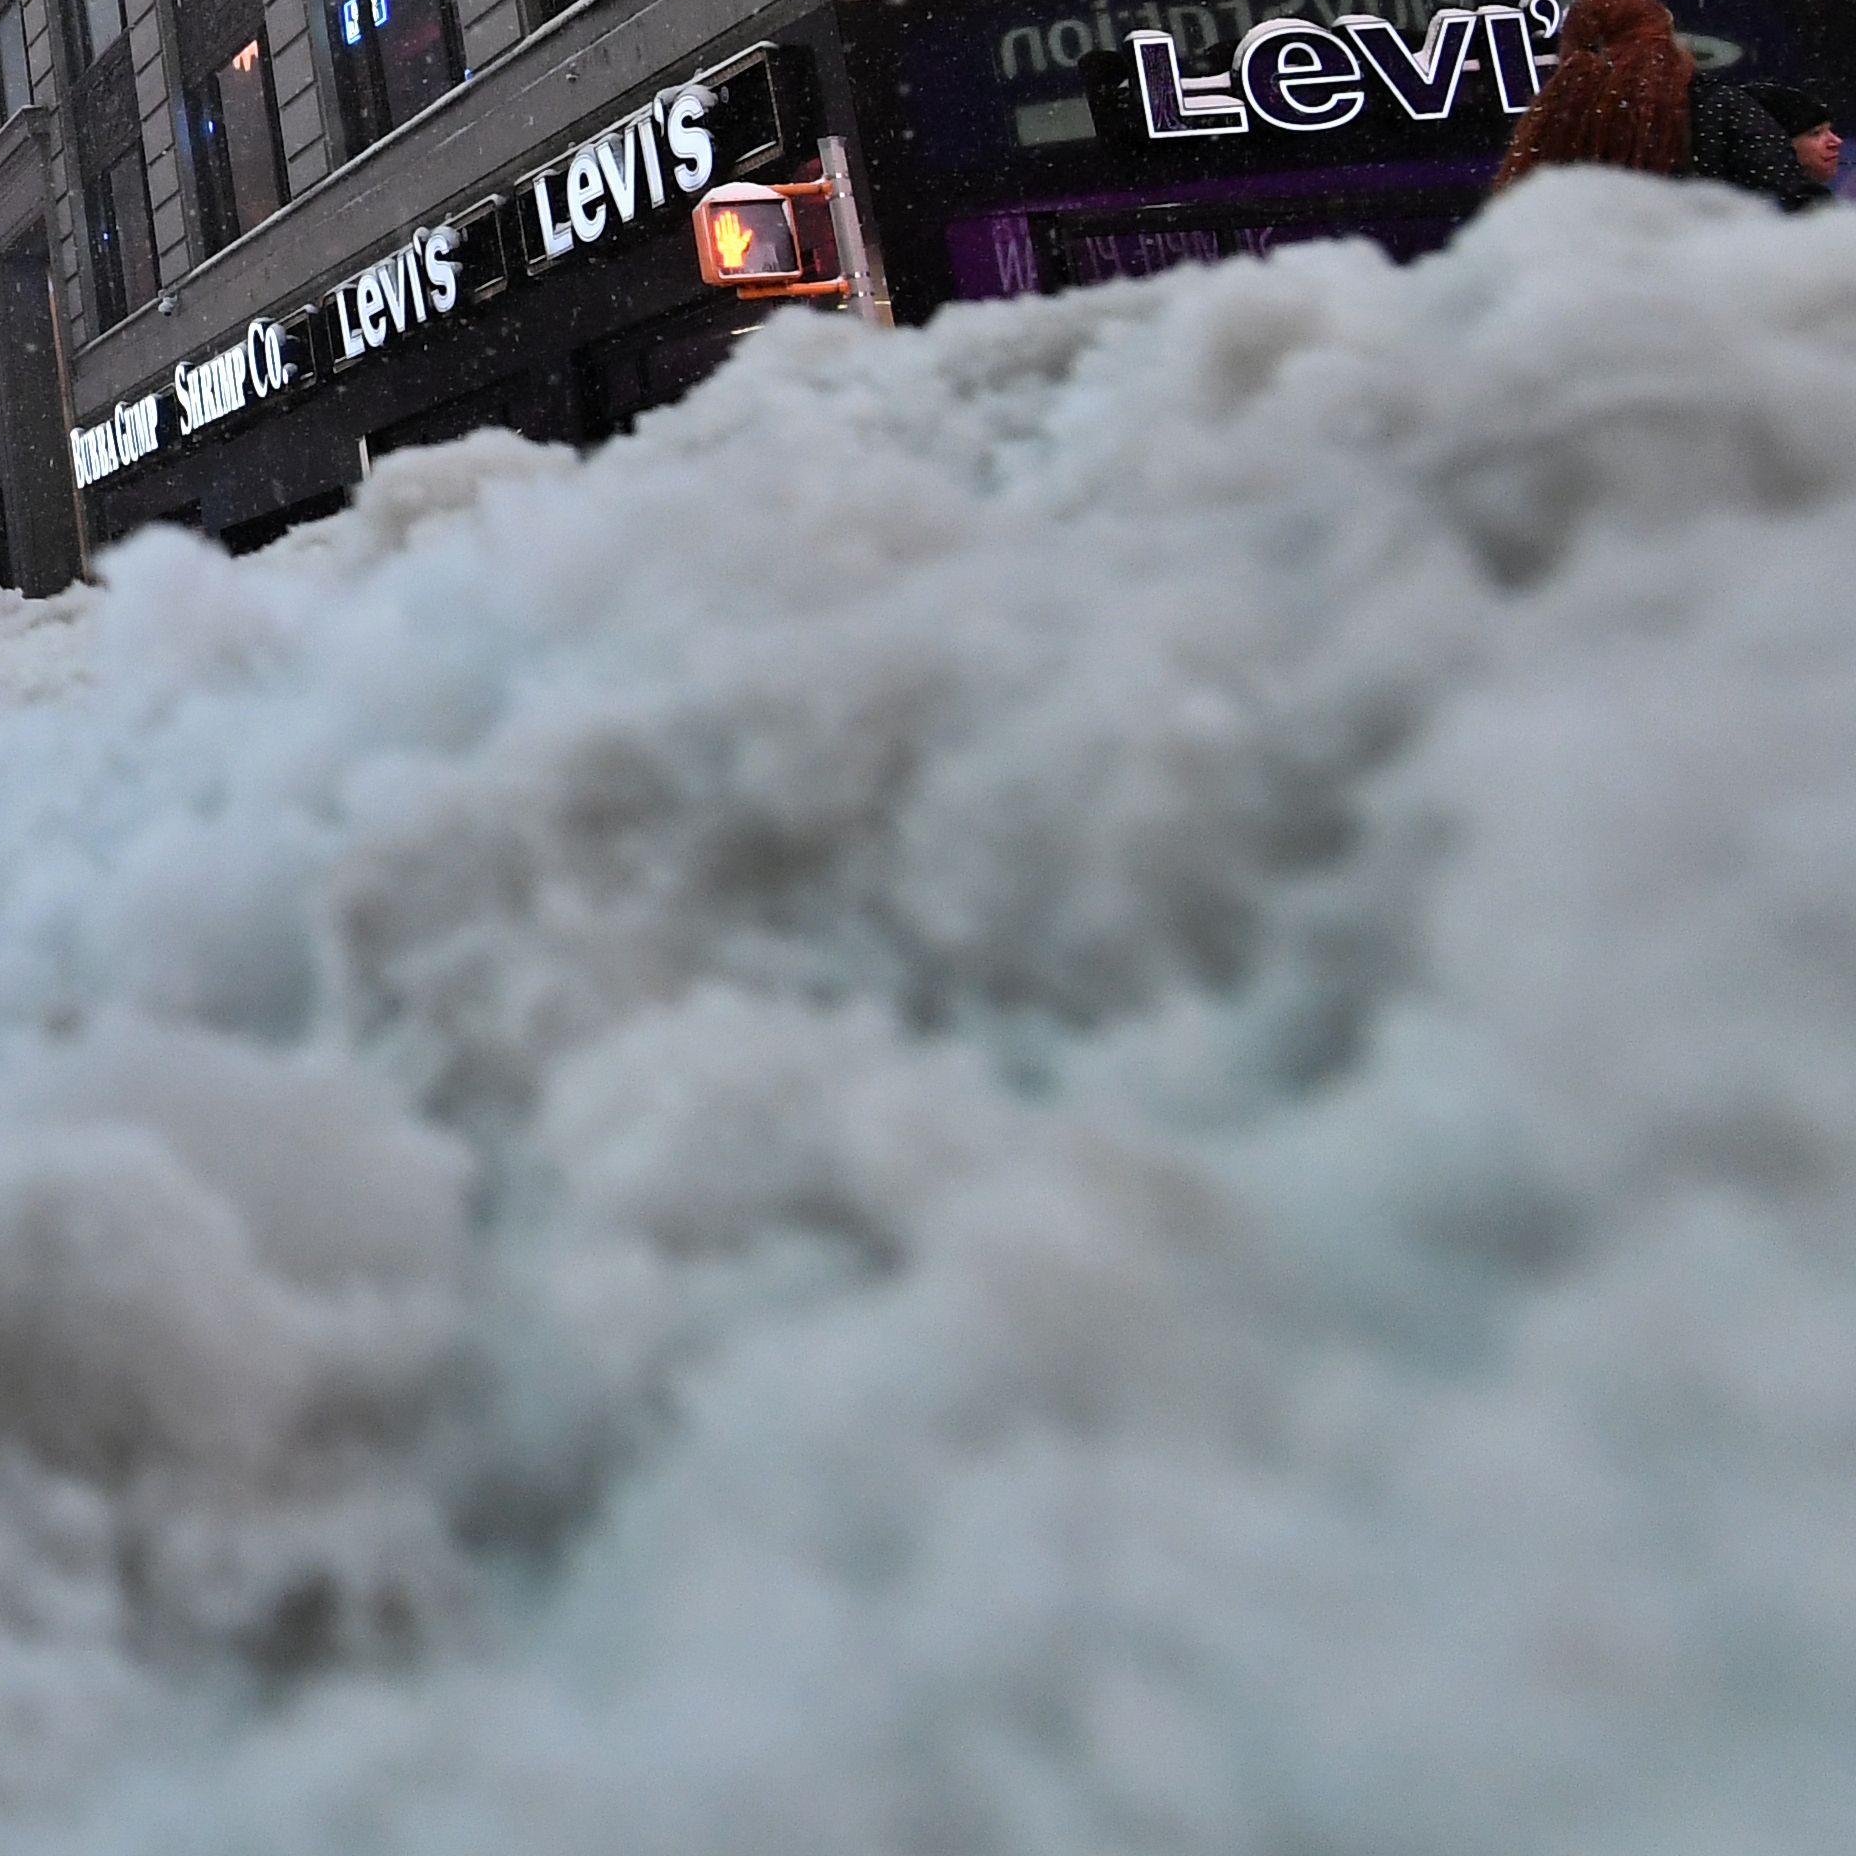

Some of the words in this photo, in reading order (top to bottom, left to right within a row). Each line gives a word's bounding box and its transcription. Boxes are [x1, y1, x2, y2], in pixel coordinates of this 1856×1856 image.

[70, 420, 120, 489] BUBBA
[114, 395, 159, 466] GUMP
[174, 347, 247, 436] SHRIMP
